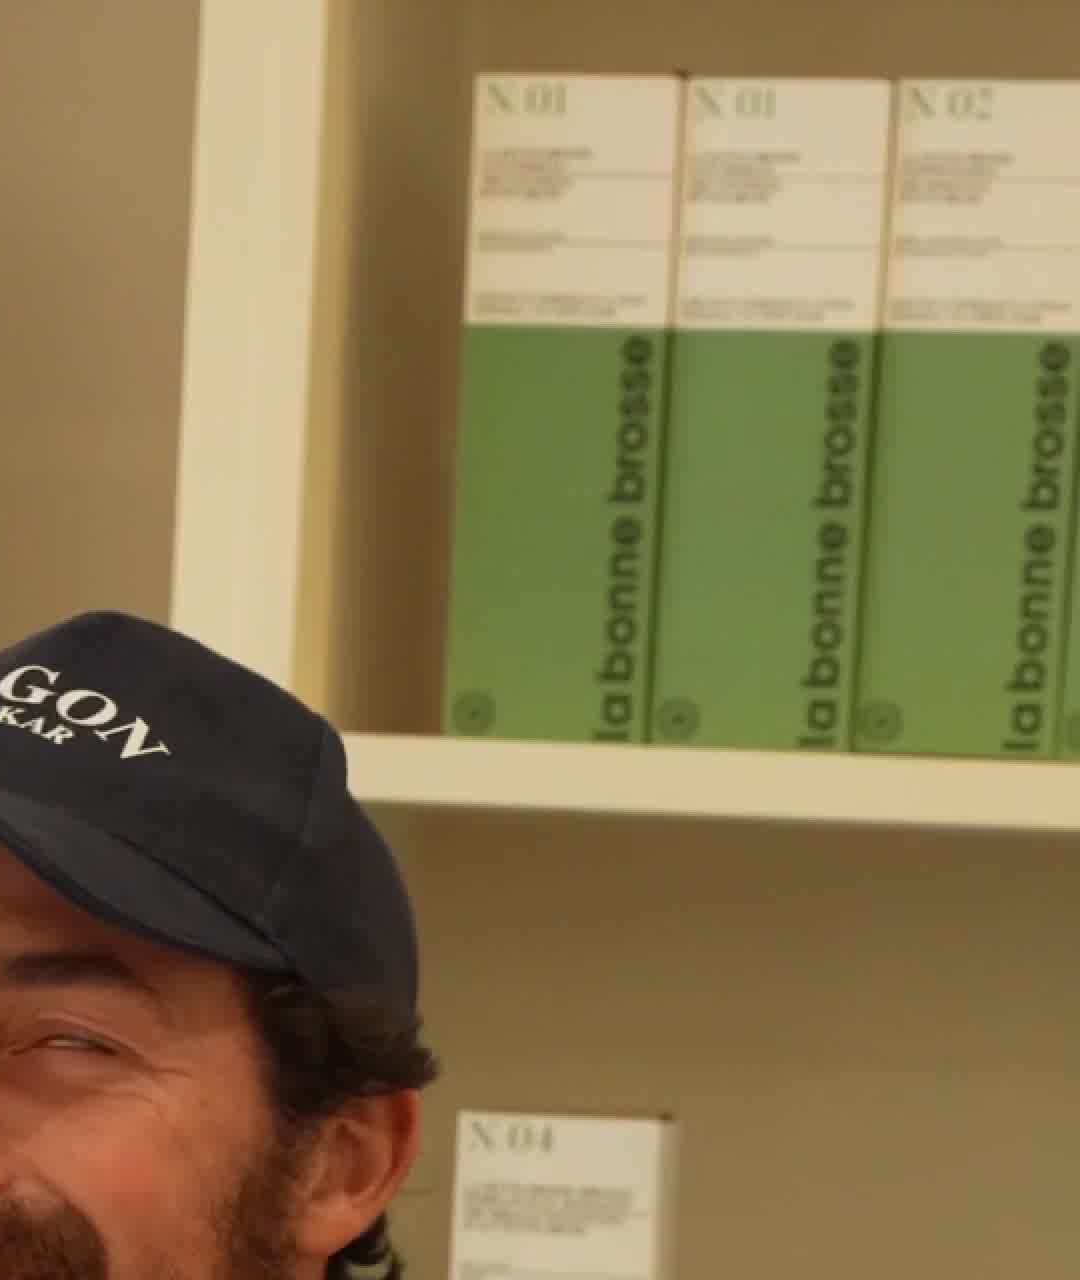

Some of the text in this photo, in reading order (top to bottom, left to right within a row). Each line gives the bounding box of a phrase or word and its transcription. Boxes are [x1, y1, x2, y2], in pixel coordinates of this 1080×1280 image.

[592, 335, 653, 743] la bonne brosse
[797, 339, 860, 748] la bonne brosse
[1001, 341, 1071, 752] la bonne brosse
